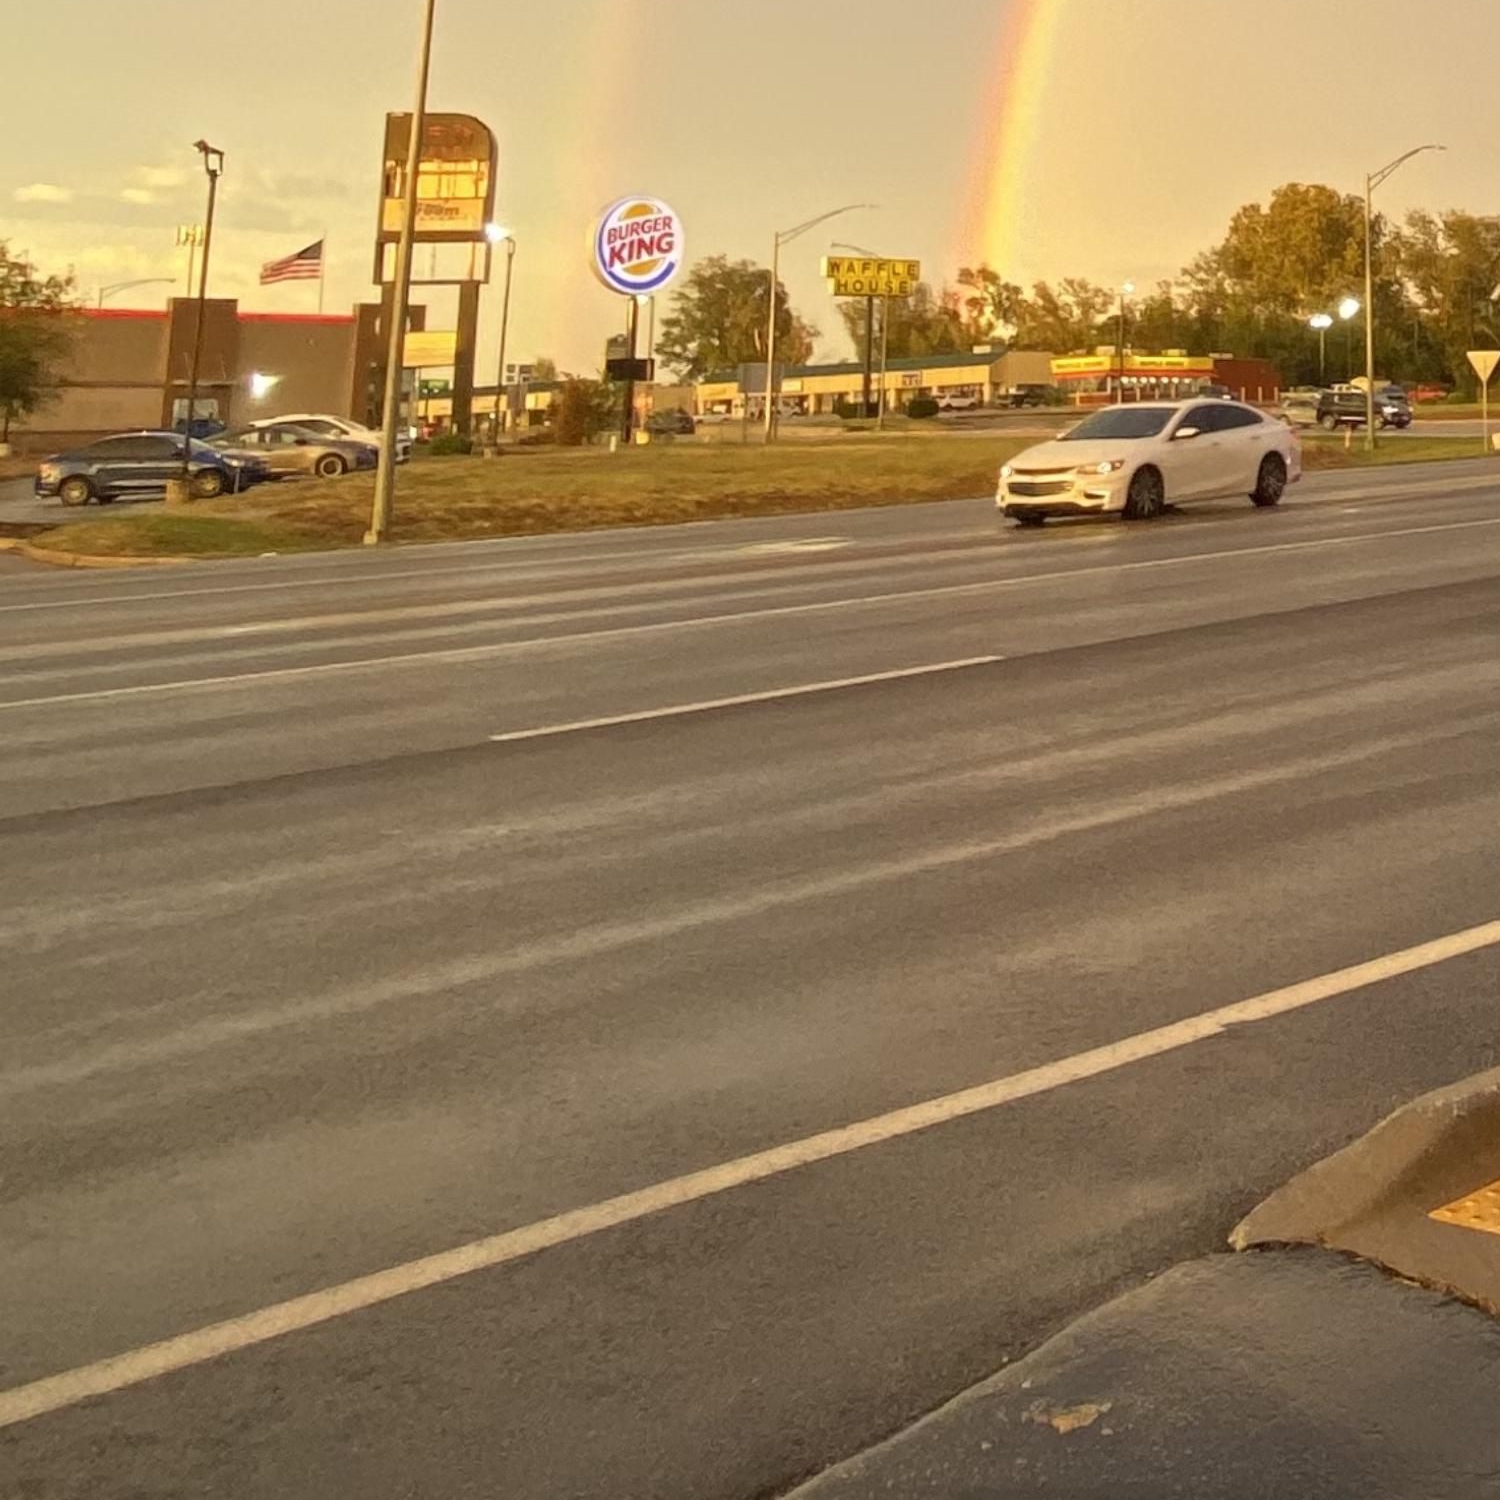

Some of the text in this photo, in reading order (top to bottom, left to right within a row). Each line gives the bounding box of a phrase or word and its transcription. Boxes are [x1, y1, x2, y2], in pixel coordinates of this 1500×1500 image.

[607, 216, 673, 245] BURGER
[608, 232, 675, 268] KING
[830, 260, 916, 276] WAFFLE
[836, 279, 909, 293] HOUSE
